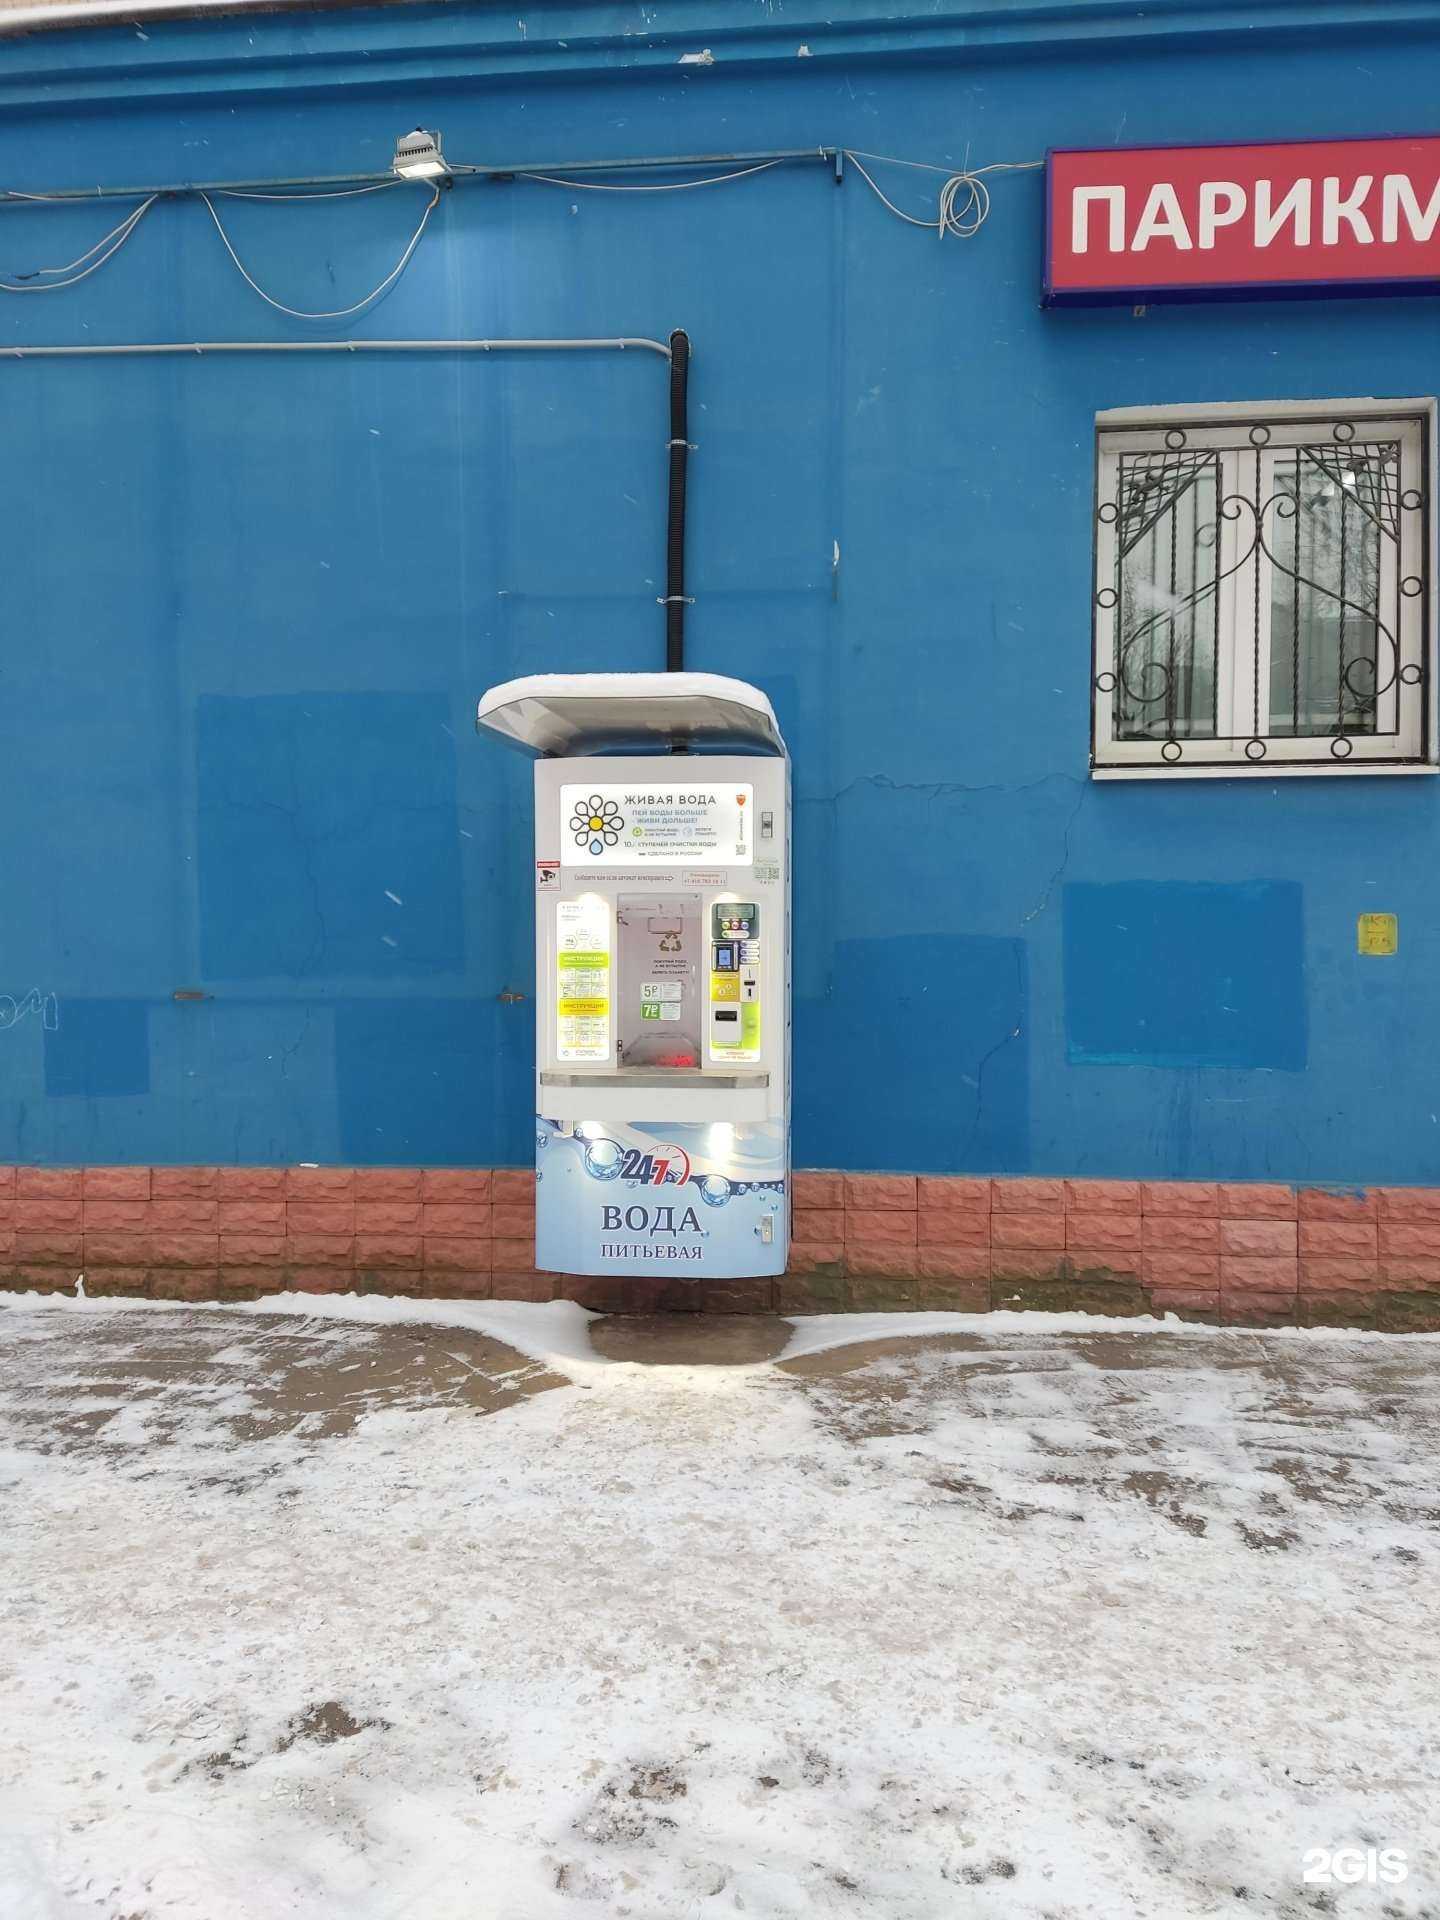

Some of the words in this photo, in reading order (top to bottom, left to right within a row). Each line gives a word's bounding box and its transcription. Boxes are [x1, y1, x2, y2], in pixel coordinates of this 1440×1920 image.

[624, 795, 673, 805] ЖИВАЯ
[679, 795, 717, 806] ВОДА
[601, 1205, 702, 1237] ВОДА
[601, 1244, 703, 1260] ПИТЬЕВАЯ
